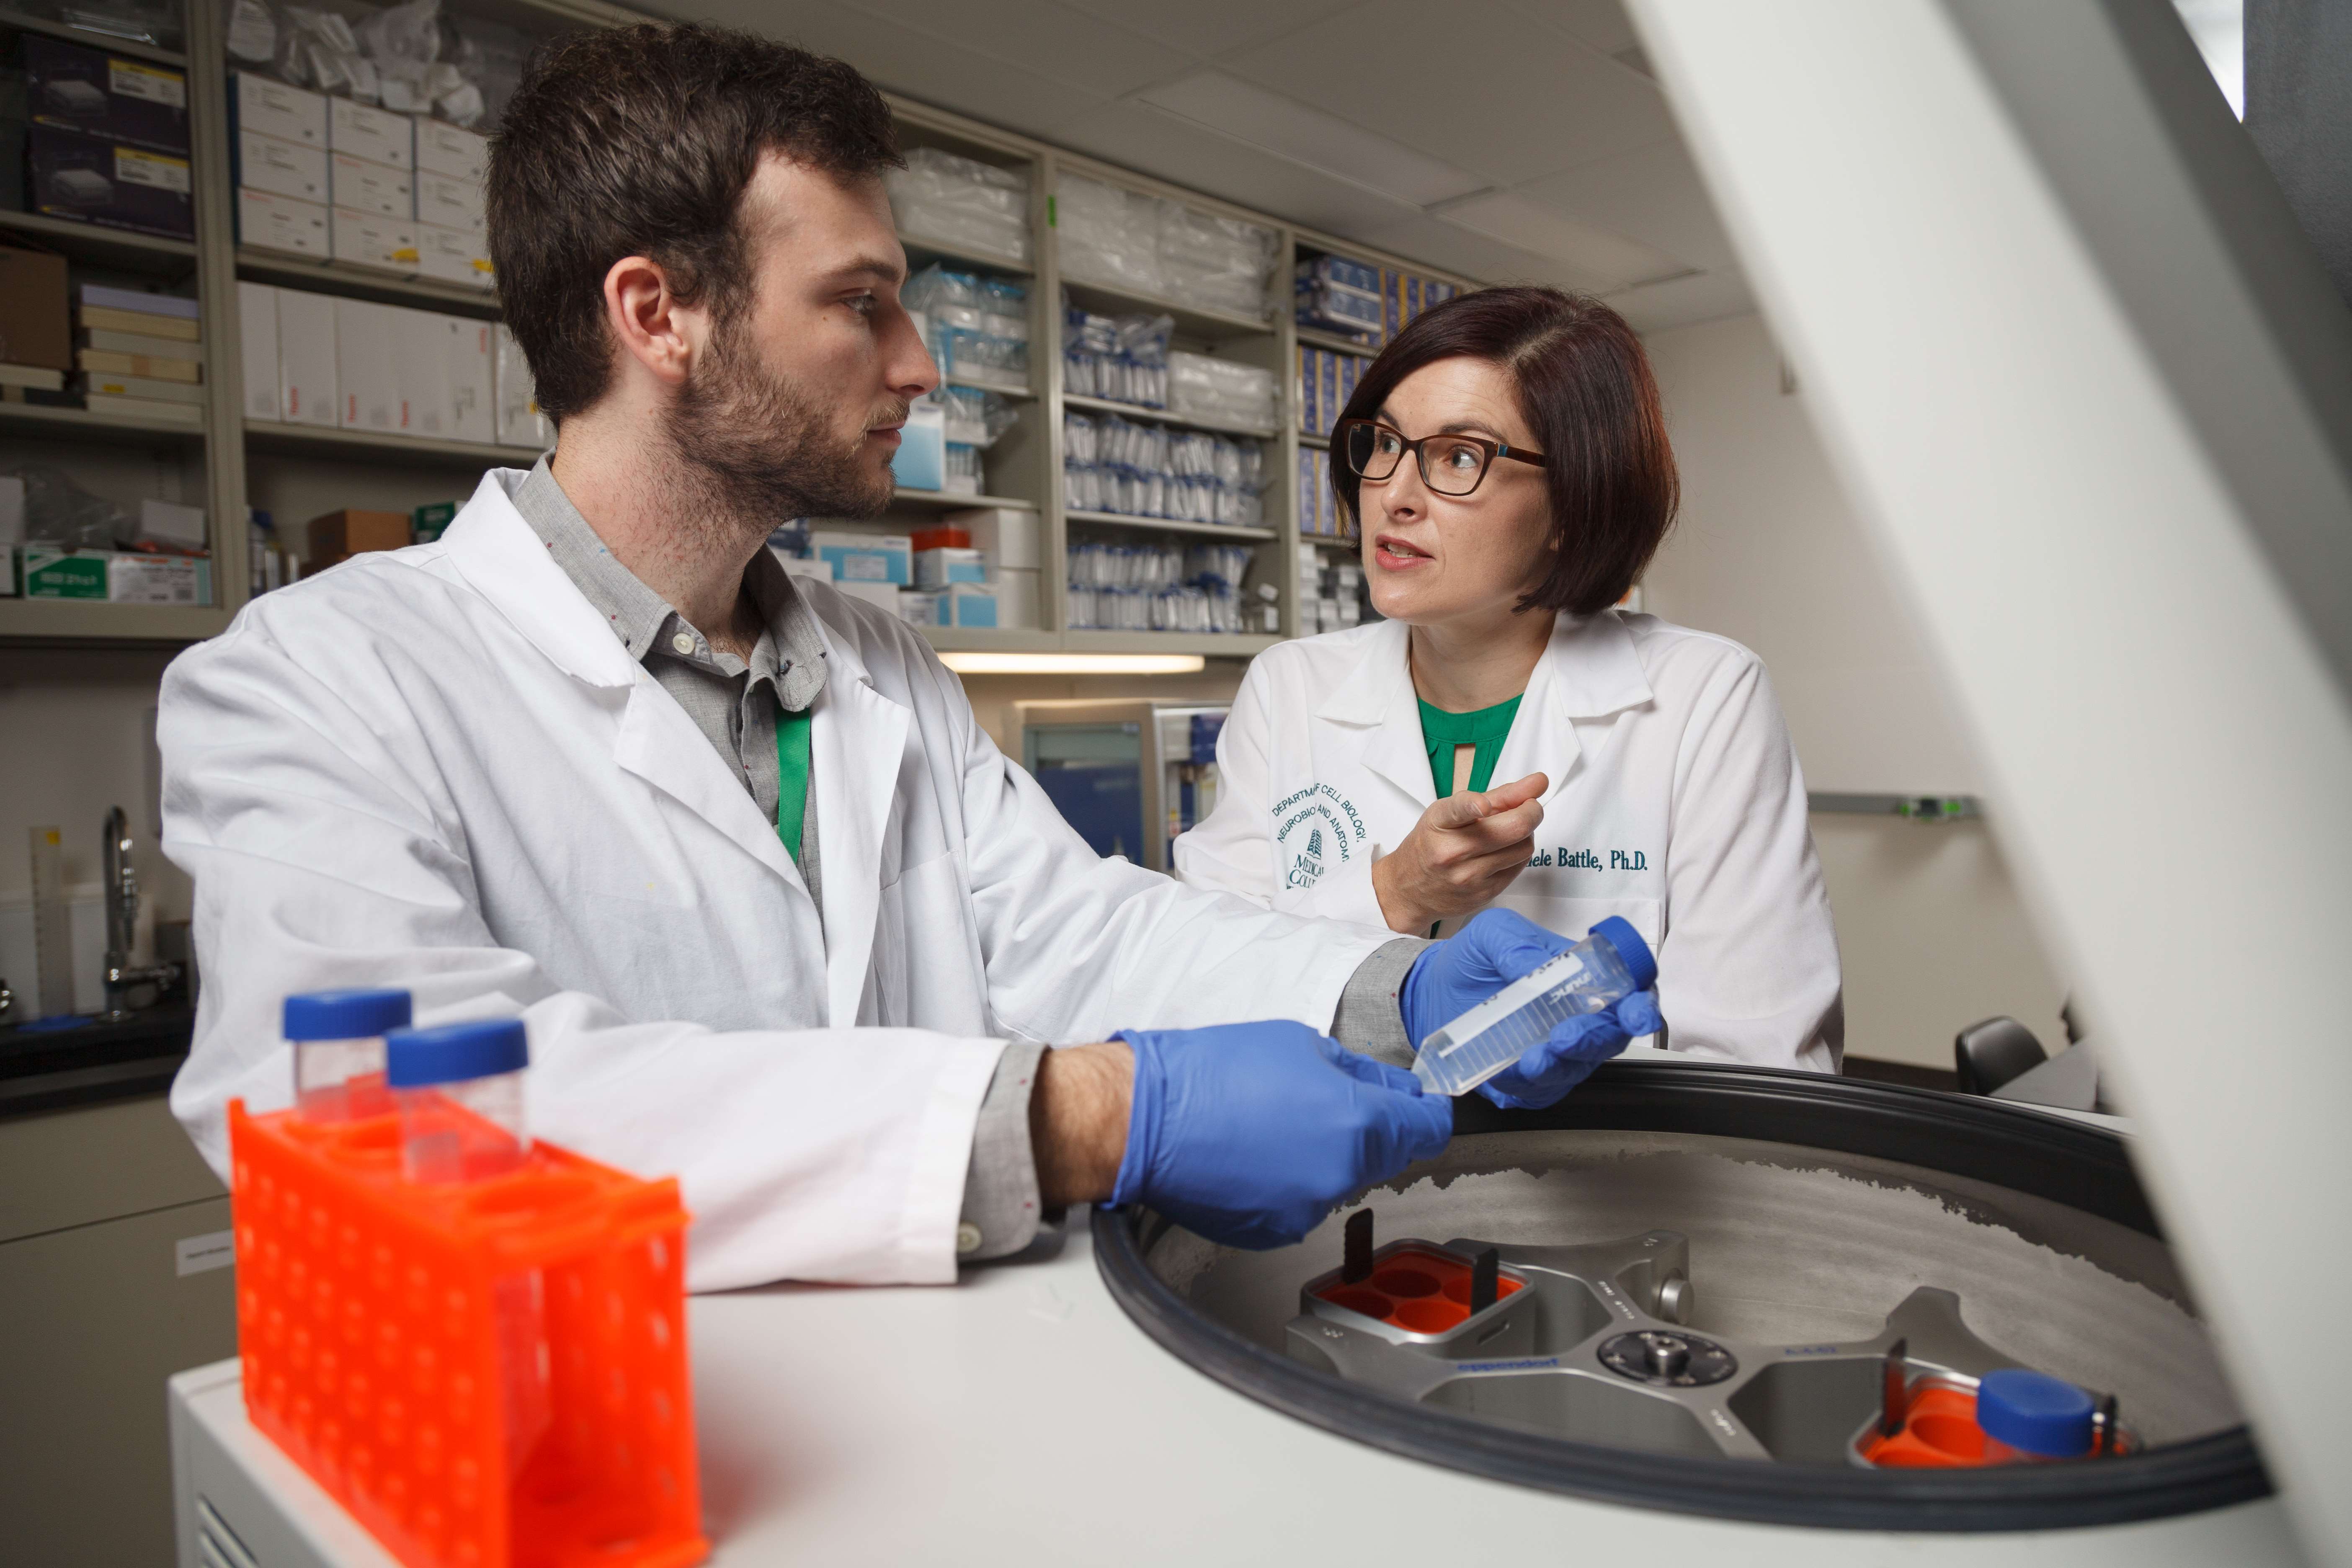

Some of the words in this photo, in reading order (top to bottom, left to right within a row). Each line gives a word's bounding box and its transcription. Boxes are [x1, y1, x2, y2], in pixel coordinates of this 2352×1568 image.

[1317, 804, 1331, 818] AND
[1321, 785, 1341, 802] CELL
[1341, 800, 1366, 842] BIOLOGY,
[1558, 847, 1603, 872] Battle,
[1610, 850, 1648, 870] Ph.D.
